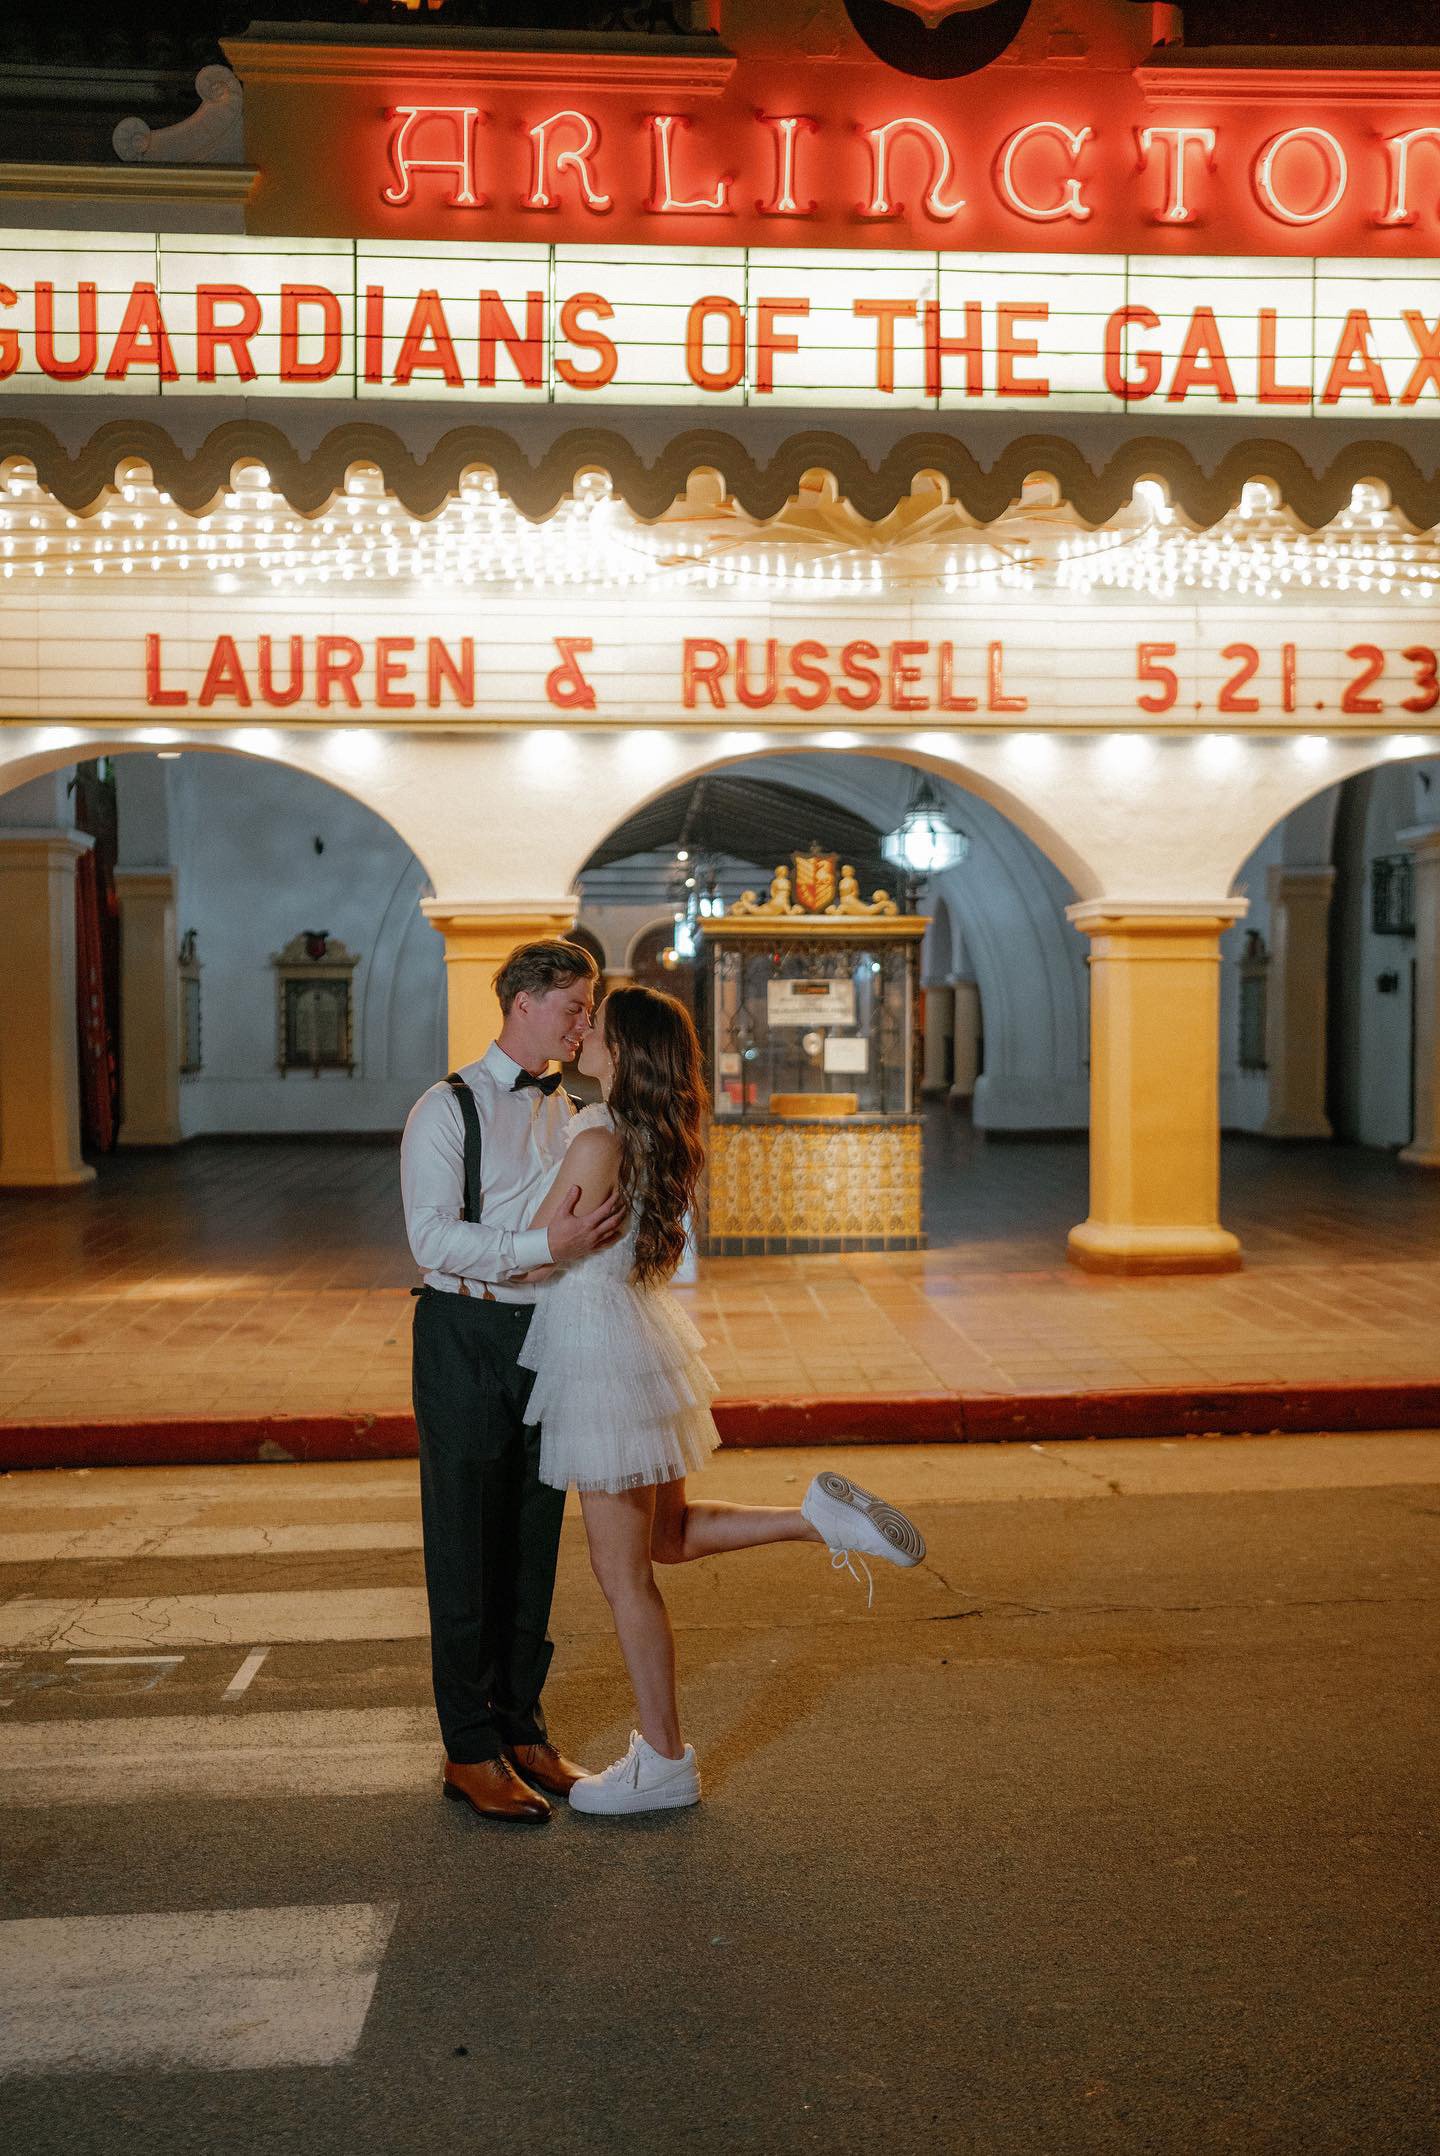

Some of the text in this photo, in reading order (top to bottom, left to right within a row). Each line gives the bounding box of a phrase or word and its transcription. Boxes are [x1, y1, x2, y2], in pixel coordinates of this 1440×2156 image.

[685, 296, 810, 394] OF
[853, 299, 1050, 399] THE
[145, 633, 1440, 714] LAUREN & RUSSELL 5.21.23
